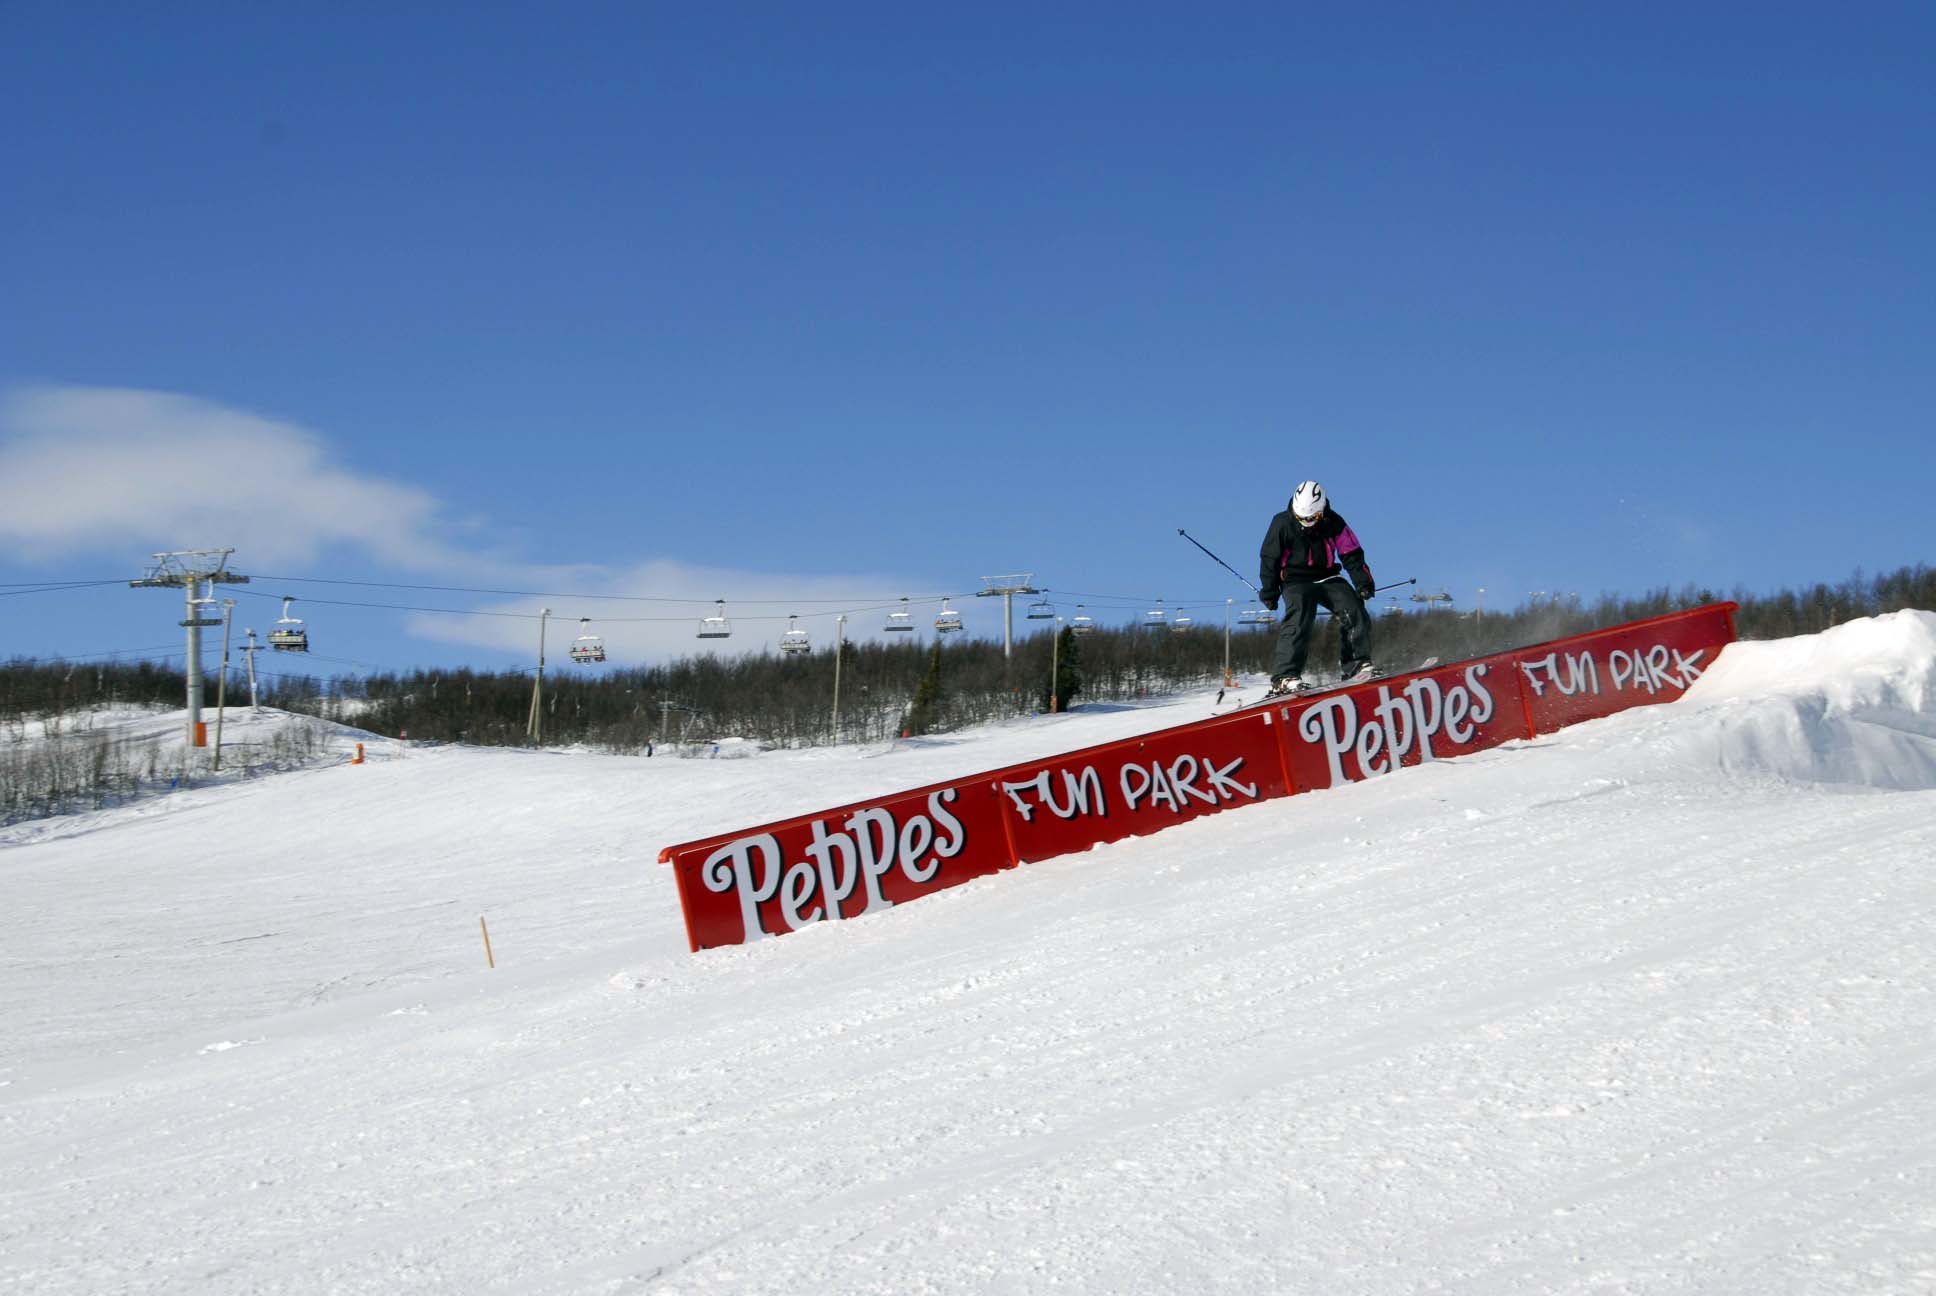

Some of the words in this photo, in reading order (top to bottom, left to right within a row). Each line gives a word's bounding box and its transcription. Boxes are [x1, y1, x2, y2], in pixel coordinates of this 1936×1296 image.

[1300, 664, 1494, 788] Peppes
[1520, 646, 1599, 696] FUN
[1609, 645, 1705, 695] PARK
[702, 788, 966, 944] Peppes
[1002, 766, 1107, 822] FUN
[1120, 754, 1257, 813] PARK
